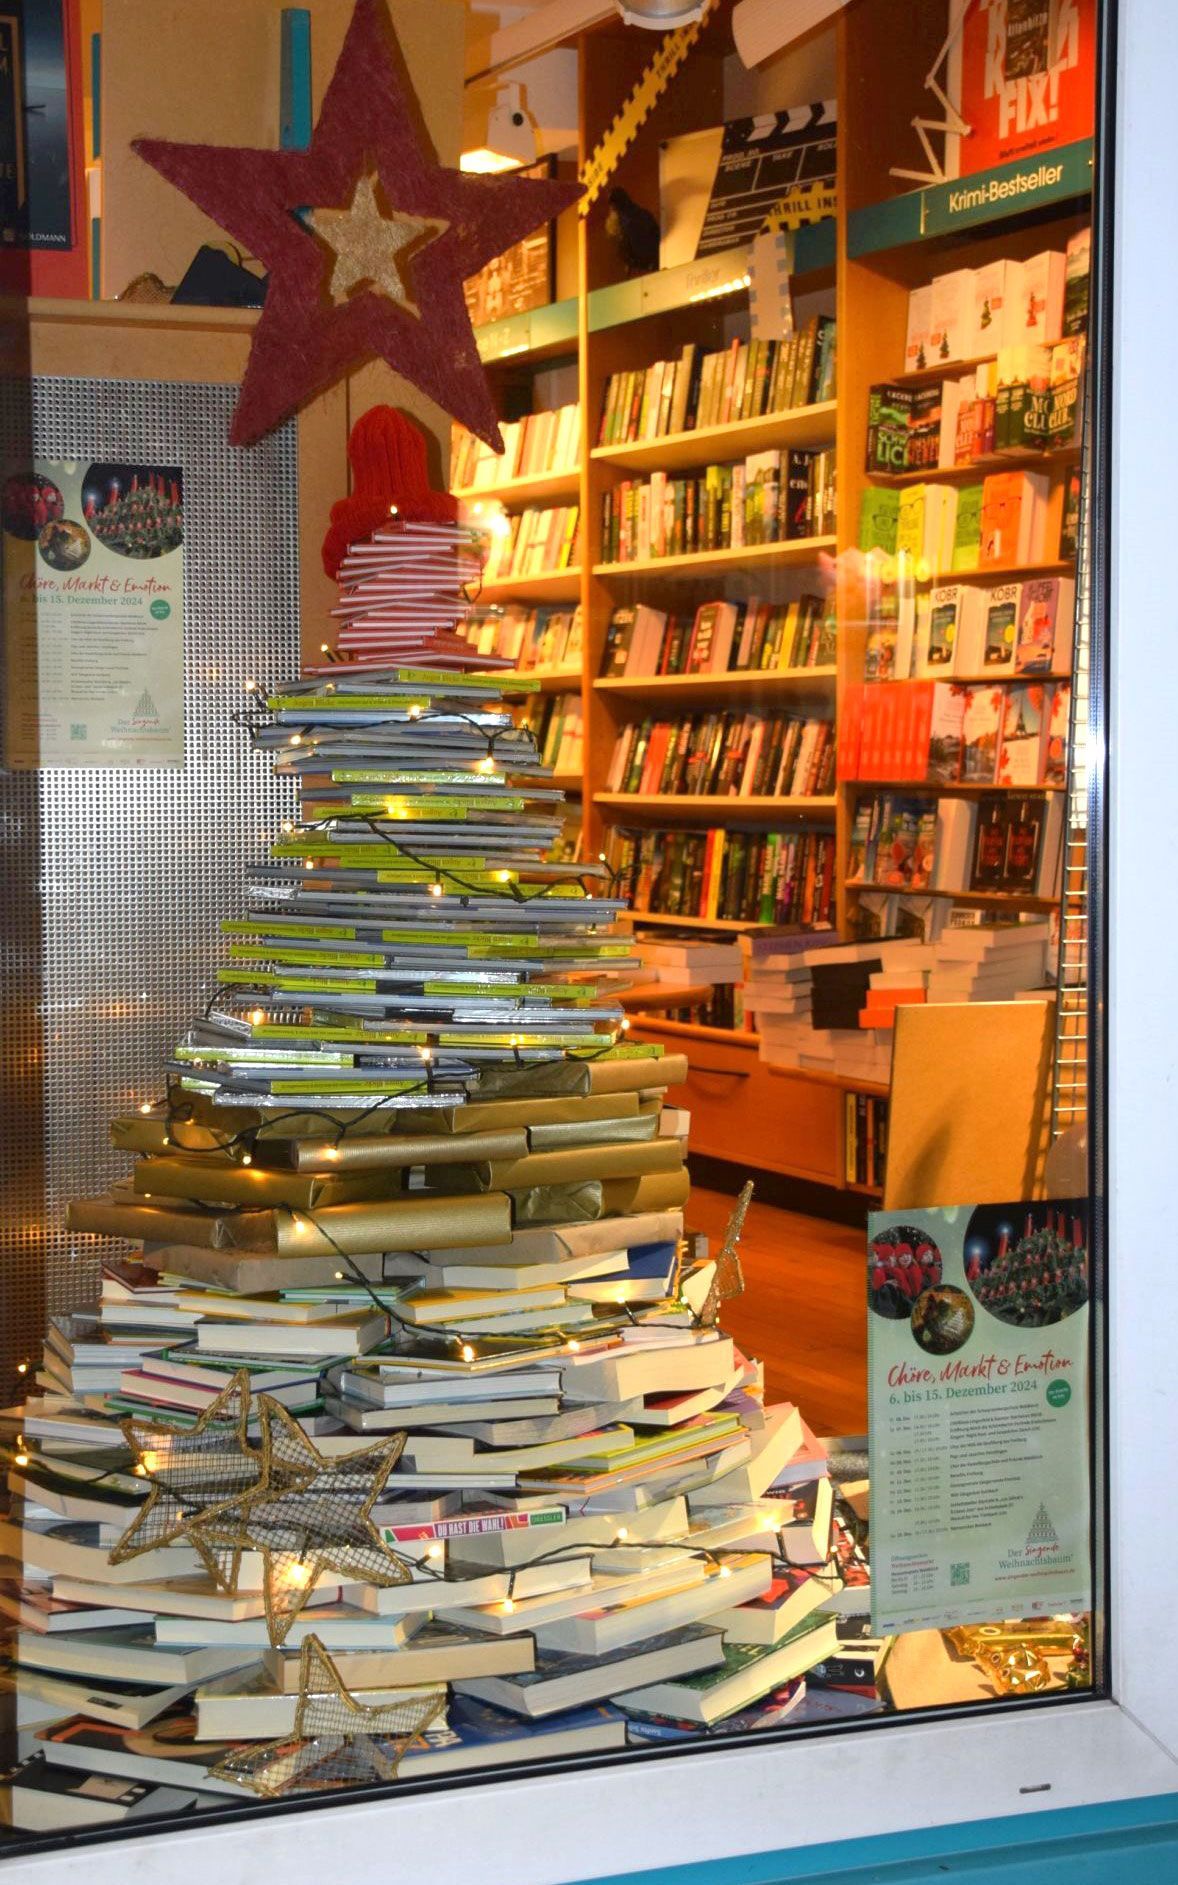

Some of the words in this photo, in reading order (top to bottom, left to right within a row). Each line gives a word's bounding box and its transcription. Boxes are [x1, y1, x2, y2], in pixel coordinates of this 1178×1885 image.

[998, 68, 1062, 140] FIX!
[949, 164, 1063, 214] Krimi-Bestseller
[63, 574, 110, 594] Markt
[109, 578, 120, 591] &
[124, 575, 172, 596] Emotion
[991, 587, 1017, 602] KOBR
[67, 595, 118, 605] Dezember
[120, 596, 143, 606] 2024
[887, 1359, 937, 1388] Chöre,
[940, 1353, 996, 1382] Markt
[996, 1358, 1012, 1377] &
[1014, 1348, 1075, 1378] Emotion
[889, 1392, 900, 1405] 6.
[903, 1389, 922, 1404] bis
[925, 1388, 943, 1402] 15.
[945, 1381, 1008, 1400] Dezember
[1010, 1378, 1039, 1394] 2024
[436, 1524, 448, 1537] DU
[468, 1519, 480, 1534] DIE
[481, 1516, 506, 1533] WAHL!
[1007, 1548, 1023, 1559] Der
